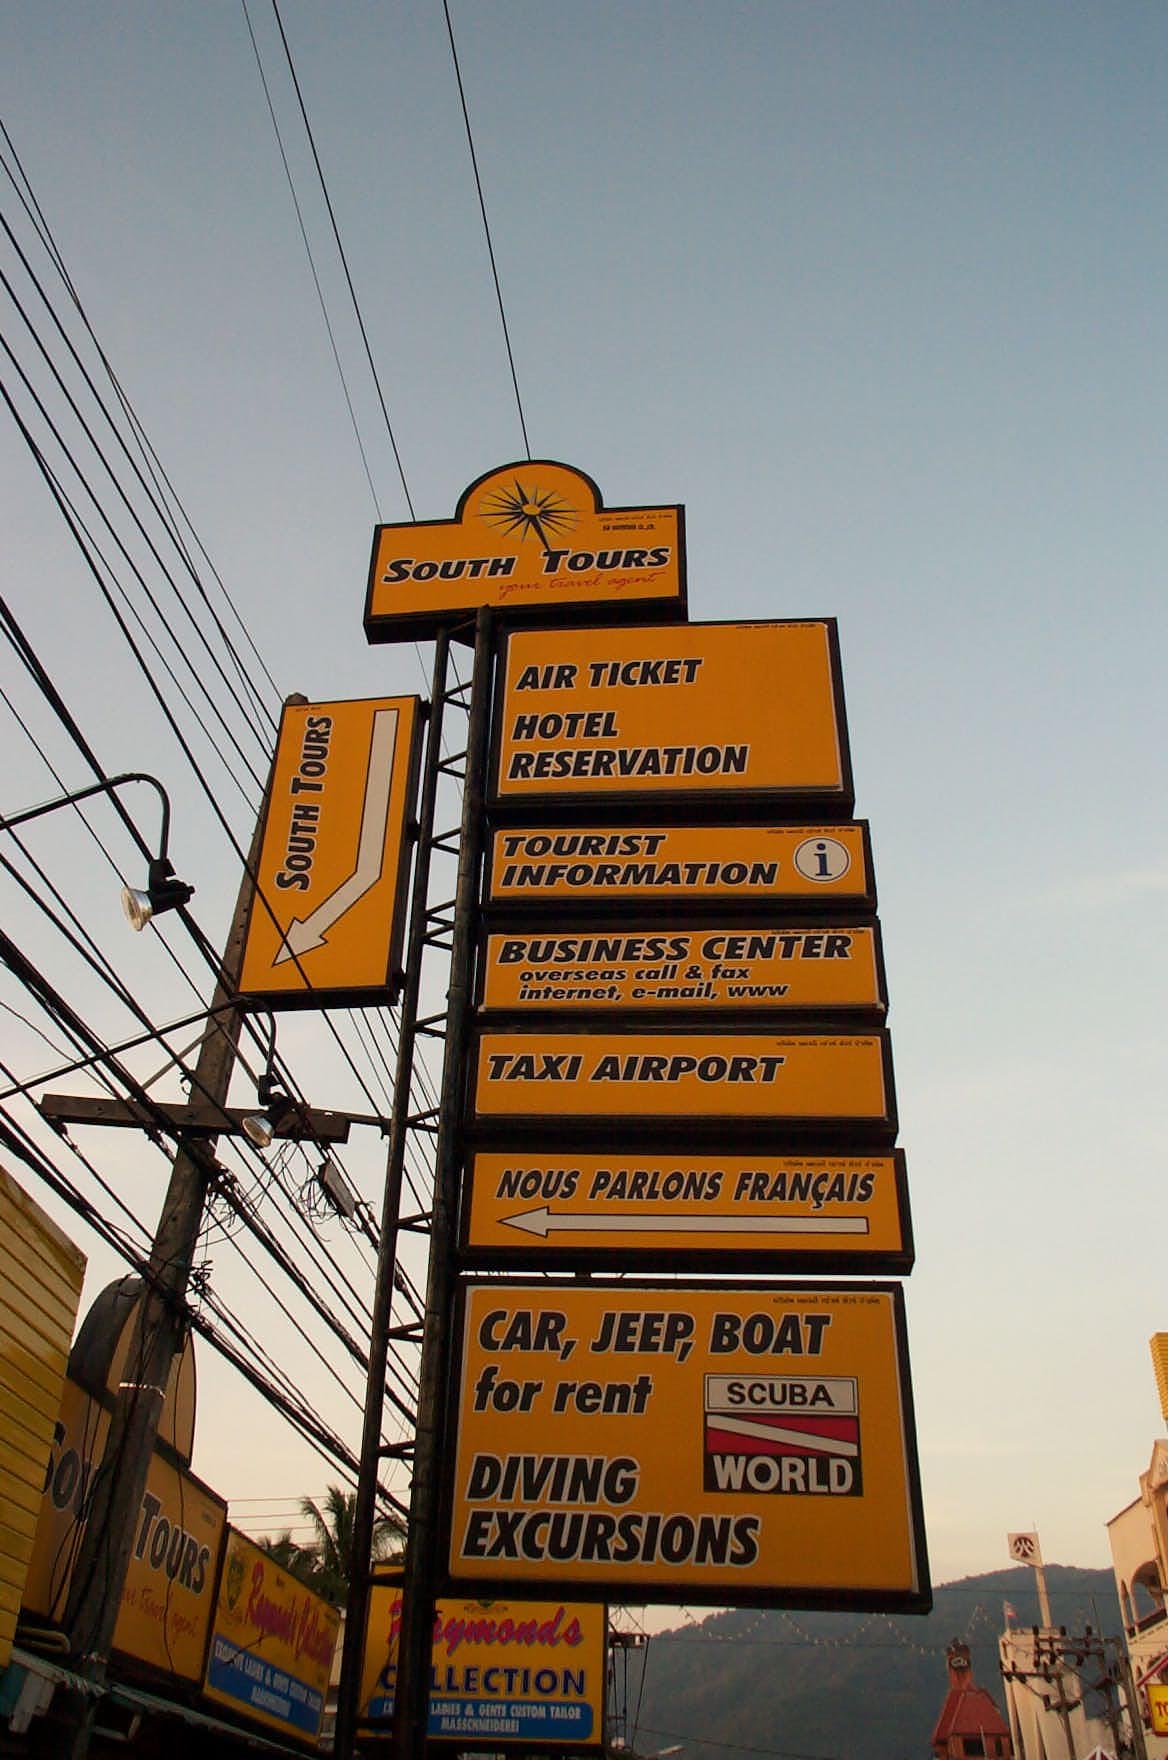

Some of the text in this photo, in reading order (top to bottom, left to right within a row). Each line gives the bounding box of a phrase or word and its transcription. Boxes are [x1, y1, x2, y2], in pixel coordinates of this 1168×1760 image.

[382, 547, 670, 584] SOUTH TOURS
[515, 658, 702, 690] AIR TICKET
[512, 711, 618, 740] HOTEL
[291, 716, 332, 795] TOURS
[508, 745, 749, 779] RESERVATION
[275, 804, 320, 891] SOUTH
[503, 835, 665, 857] TOURIST
[501, 862, 777, 887] INFORMATION
[498, 934, 852, 963] BUSINESS CENTER
[520, 964, 749, 982] overseas call & fax
[519, 983, 788, 1001] internet, e-mail, www
[488, 1054, 783, 1082] TAXI AIRPORT
[496, 1169, 875, 1208] NOUS PARLONS FRANÇAIS
[479, 1310, 831, 1363] CAR, JEEP, BOAT
[473, 1364, 653, 1415] for rent
[727, 1382, 834, 1408] SCUBA
[466, 1454, 639, 1504] DIVING
[713, 1454, 853, 1493] WORLD
[133, 1489, 210, 1595] TOURS
[460, 1509, 761, 1568] EXCURSIONS
[380, 1665, 585, 1695] CLLECTION
[550, 1706, 581, 1720] TAILOR
